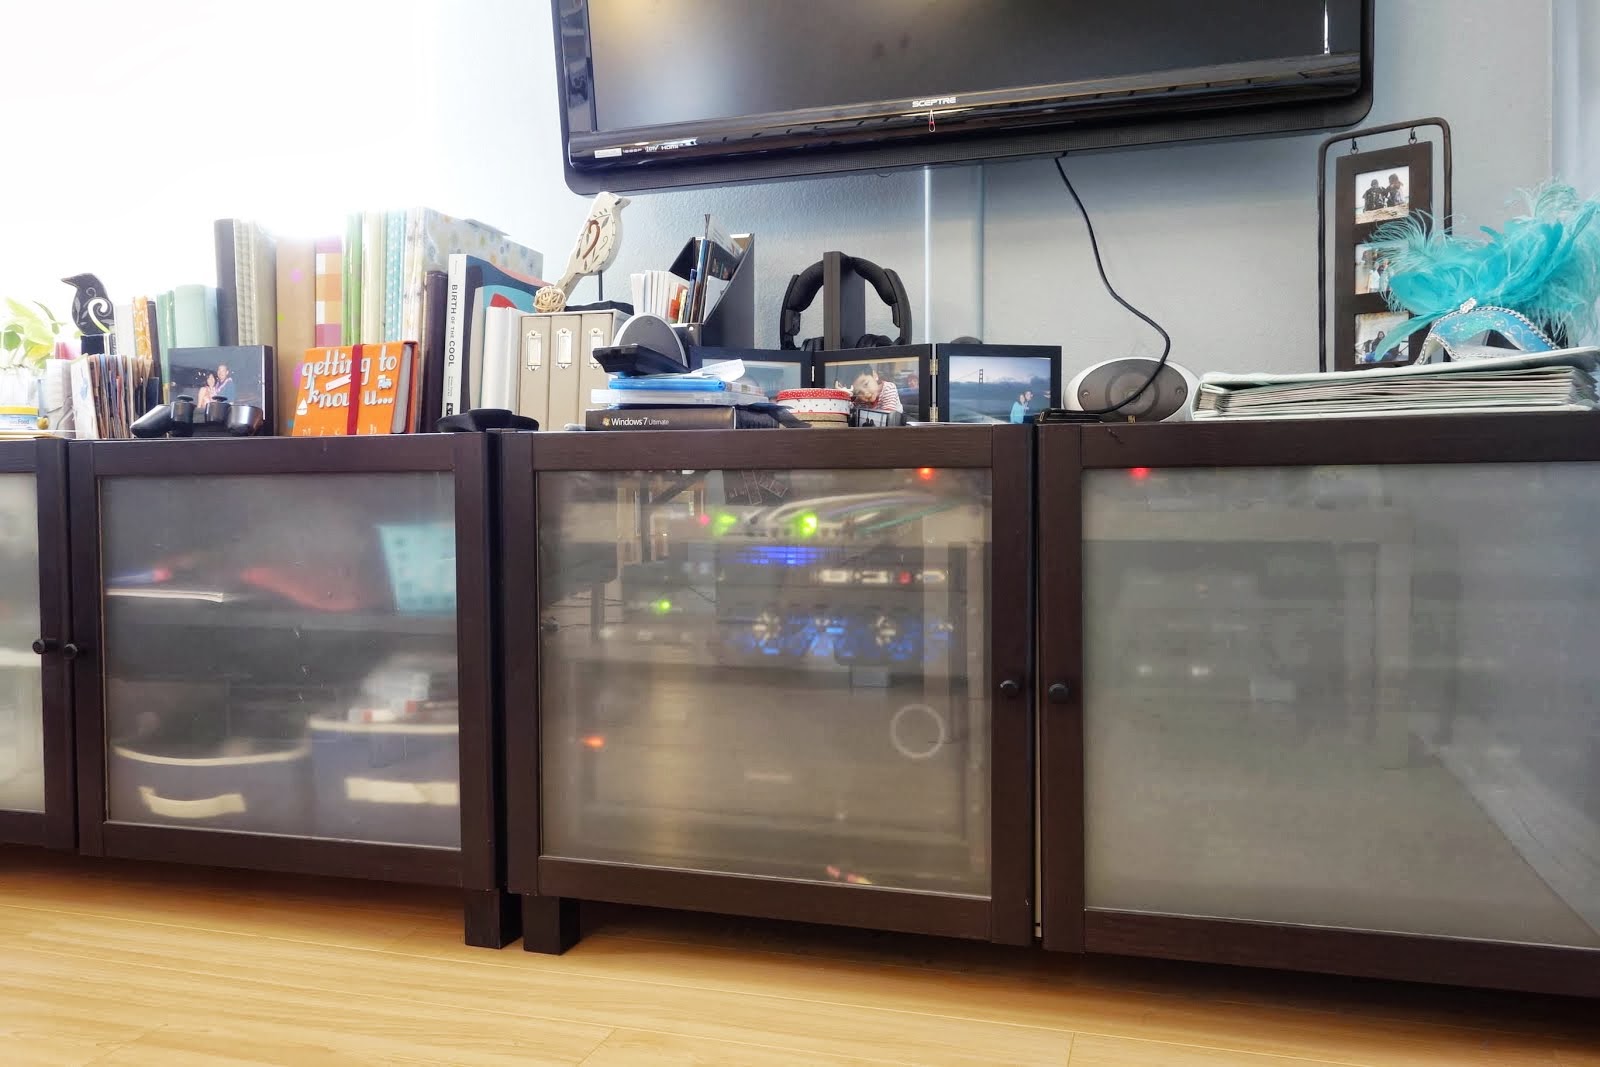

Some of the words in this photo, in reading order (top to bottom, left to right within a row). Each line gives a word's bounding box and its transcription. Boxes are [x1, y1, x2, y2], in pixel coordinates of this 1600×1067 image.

[912, 97, 956, 107] SCEPTRE
[450, 284, 458, 314] BIRTH
[450, 316, 456, 325] OF
[379, 345, 397, 372] to
[448, 340, 456, 367] COOL
[611, 417, 643, 426] Windows
[643, 417, 648, 426] 7
